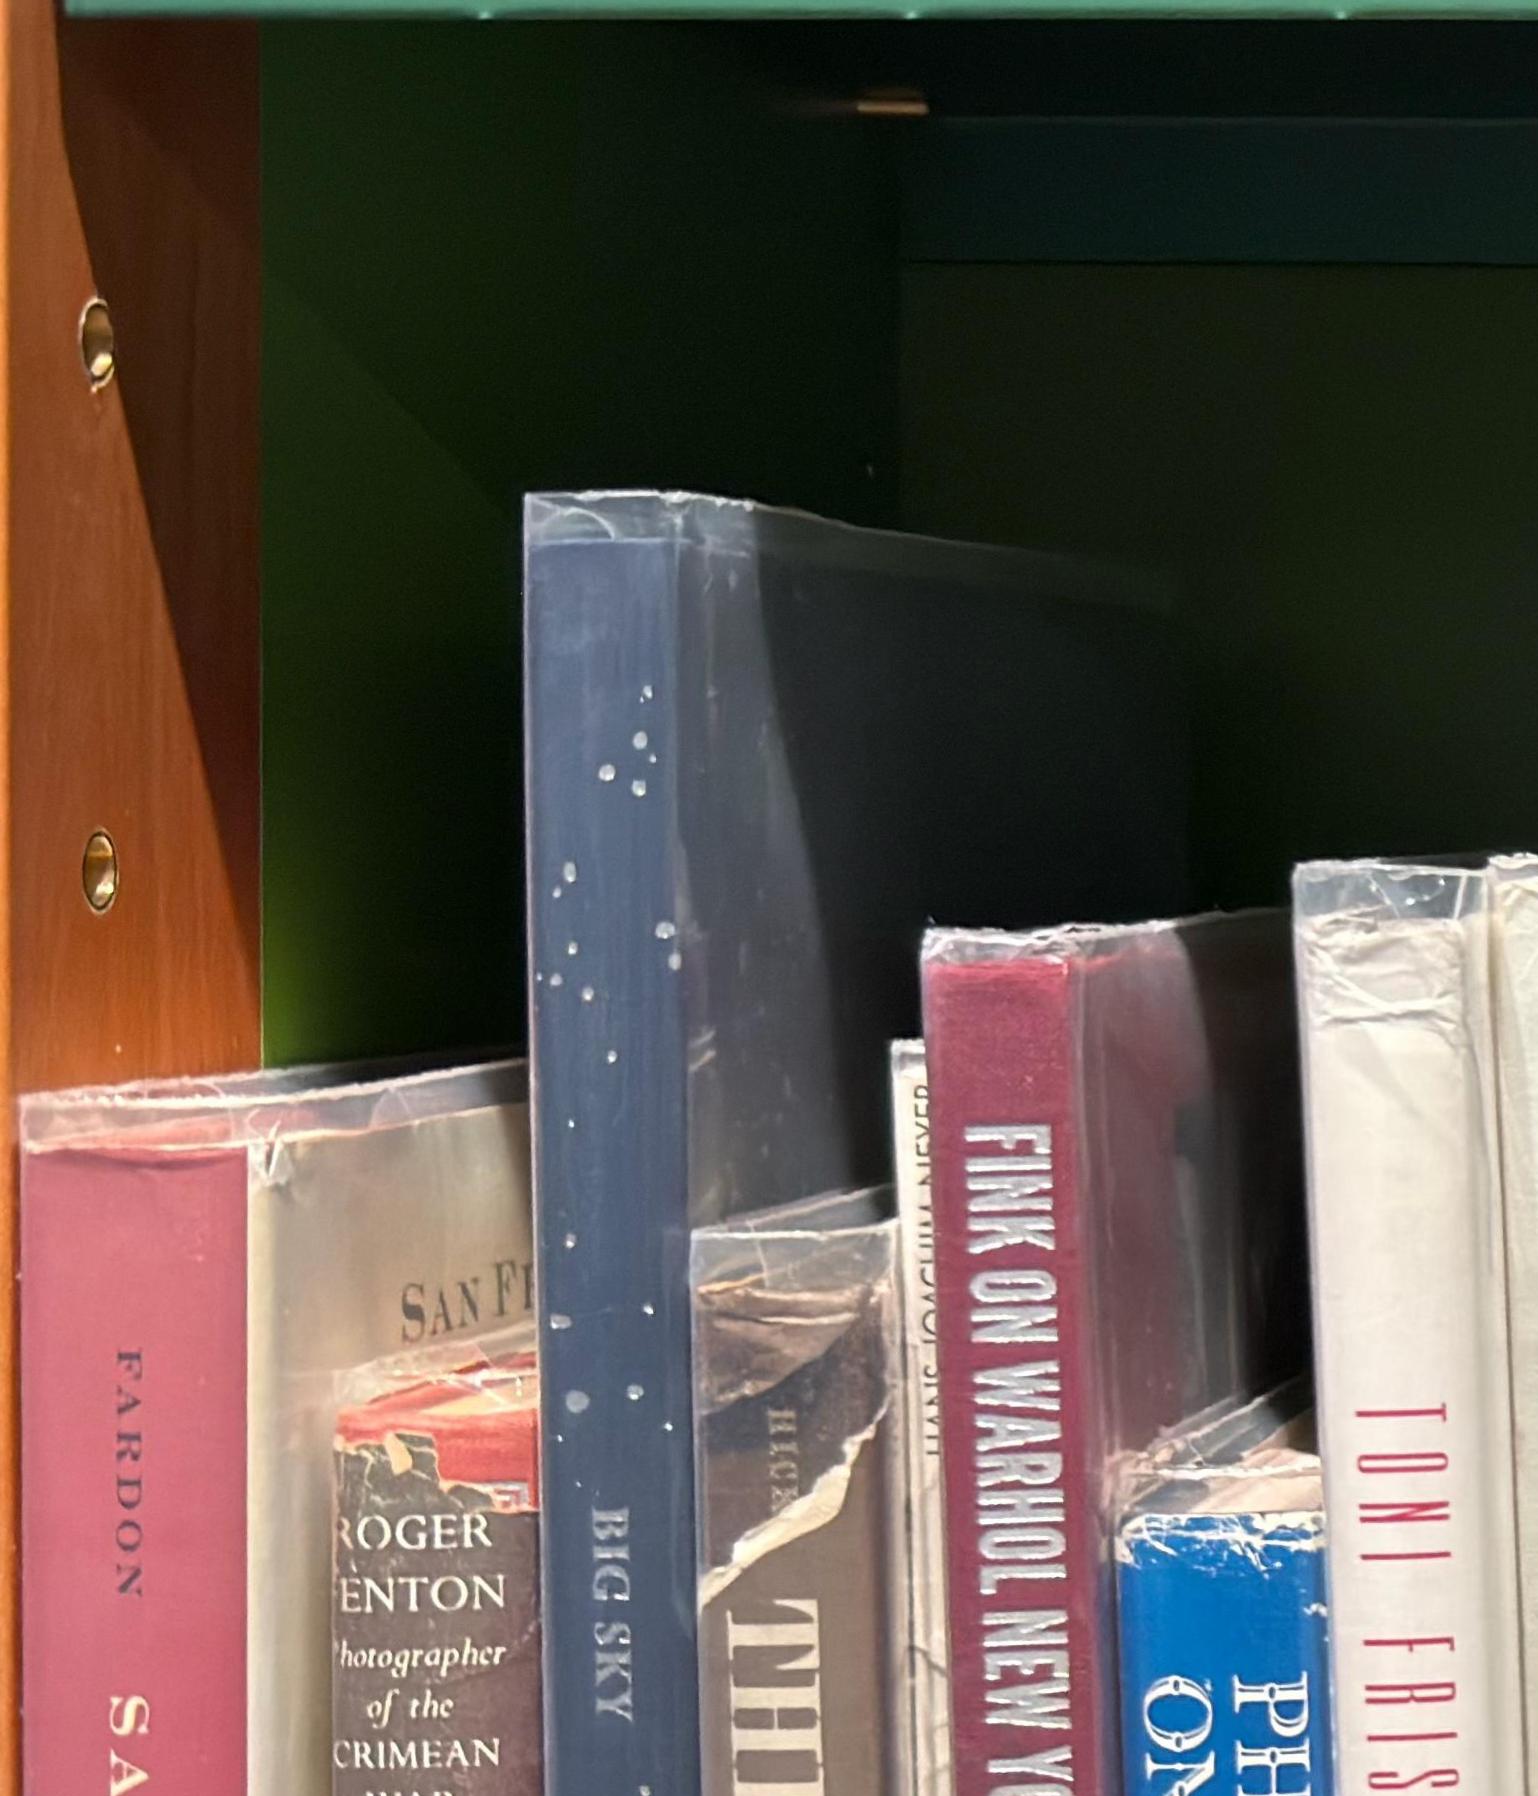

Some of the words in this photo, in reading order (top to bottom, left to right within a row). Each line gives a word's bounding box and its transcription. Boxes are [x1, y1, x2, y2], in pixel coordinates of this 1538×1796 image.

[964, 1123, 1055, 1252] FINK
[402, 1277, 480, 1343] SAN
[969, 1266, 1057, 1342] ON
[115, 1348, 144, 1597] FARDON
[768, 1408, 800, 1512] HICK
[973, 1362, 1070, 1595] WARHOL
[1353, 1402, 1451, 1562] TONI
[340, 1575, 504, 1614] ENTON
[590, 1508, 630, 1598] BIG
[340, 1637, 506, 1677] hotographer
[594, 1624, 634, 1722] SKY
[981, 1610, 1072, 1728] NEW
[334, 1739, 499, 1769] CRIMEAN
[367, 1688, 399, 1729] of
[410, 1689, 454, 1718] the
